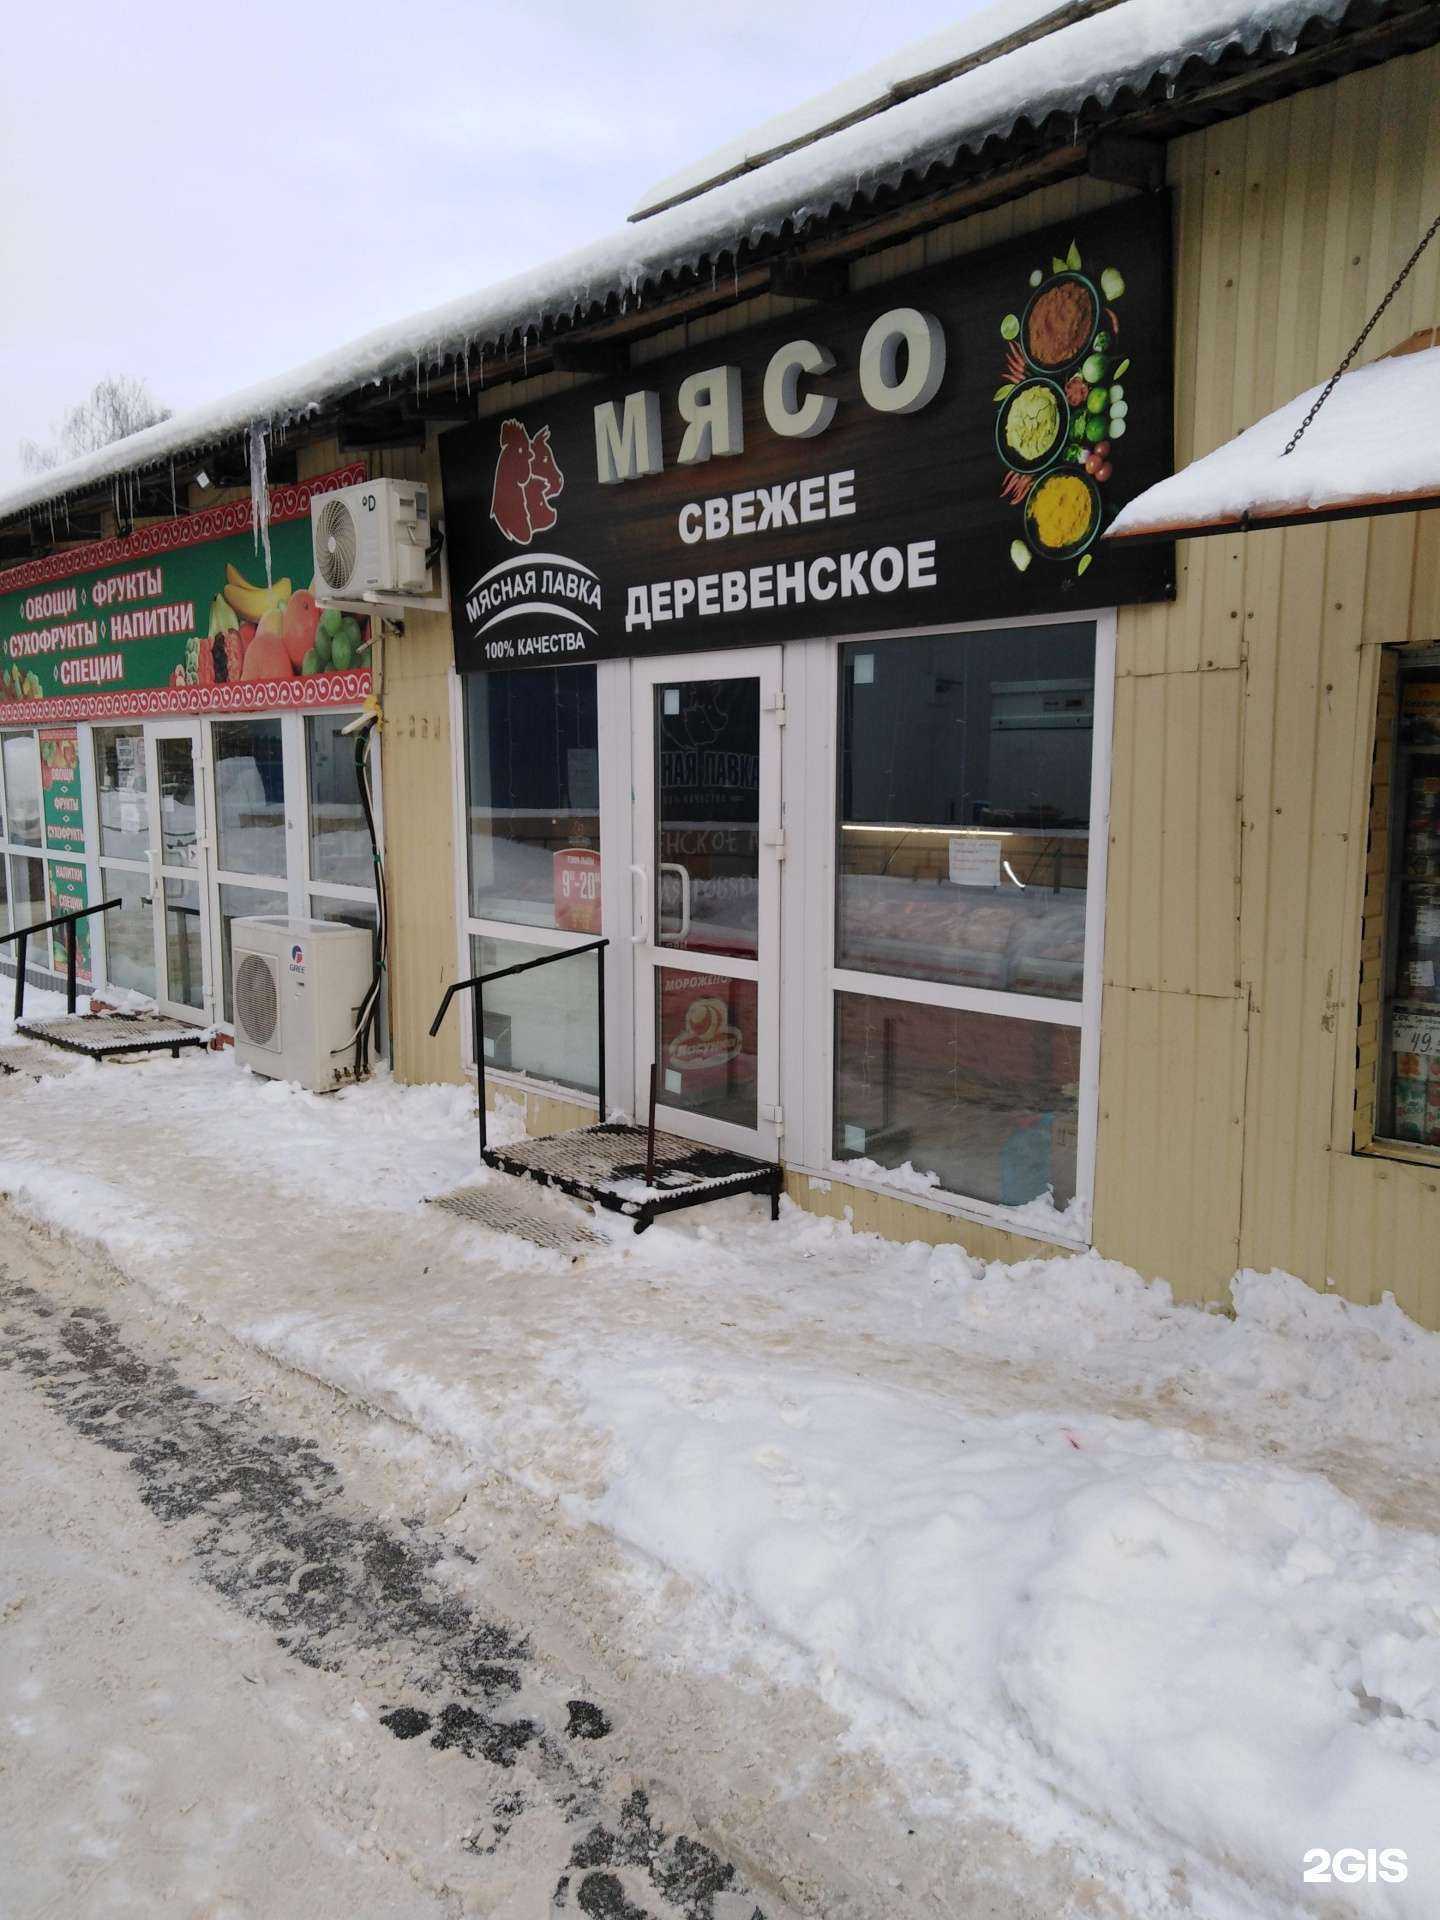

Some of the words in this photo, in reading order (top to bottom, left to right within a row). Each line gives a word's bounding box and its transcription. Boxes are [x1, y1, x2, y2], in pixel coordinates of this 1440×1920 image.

[594, 308, 947, 484] МЯСО
[678, 469, 857, 543] СВЕЖЕЕ
[25, 588, 77, 620] ОВОЩИ
[92, 568, 163, 606] ФРУКТЫ
[466, 570, 537, 623] МЯСНАЯ
[541, 570, 602, 611] ЛАВКА
[625, 540, 938, 632] ДЕРЕВЕНСКОЕ
[9, 621, 98, 657] СУХОФРУКТЫ
[110, 603, 195, 641] НАПИТКИ
[484, 640, 515, 659] 100%
[517, 632, 586, 656] КАЧЕСТВА
[60, 654, 123, 685] СПЕЦИИ
